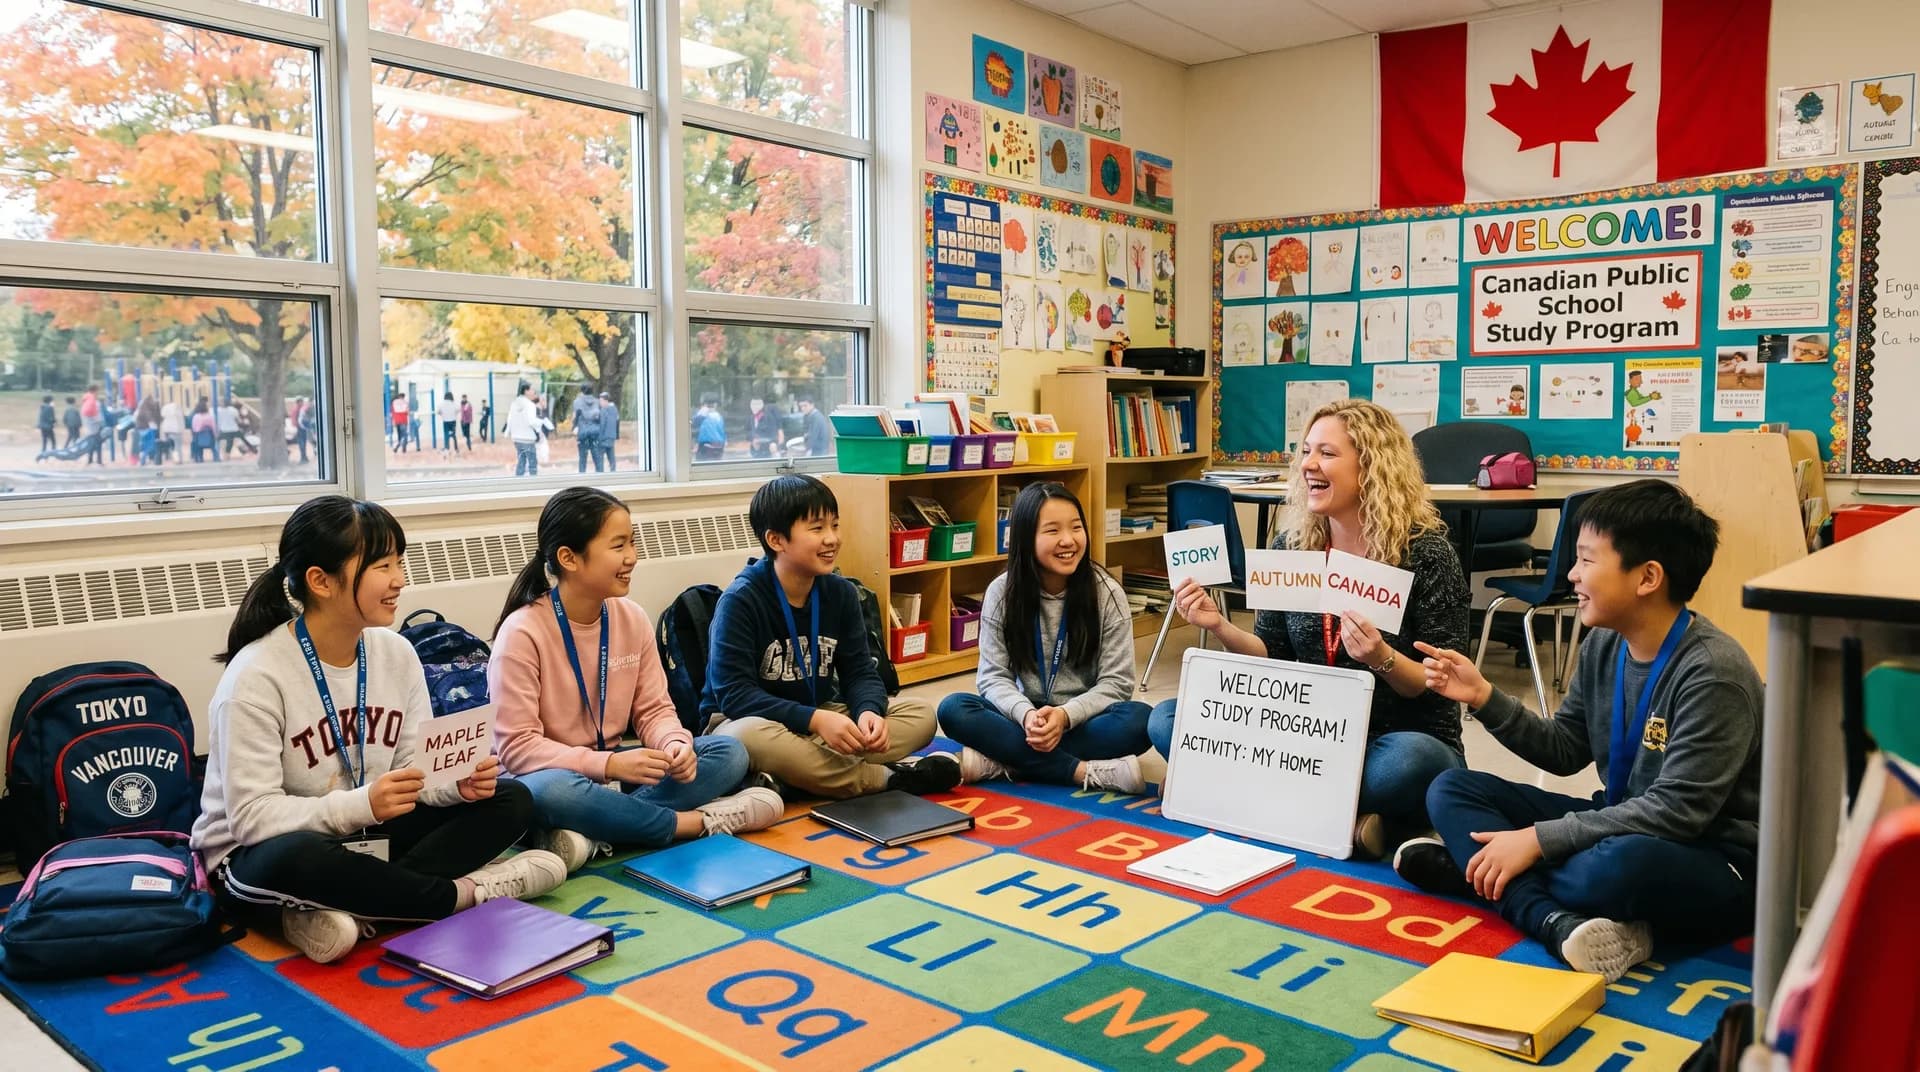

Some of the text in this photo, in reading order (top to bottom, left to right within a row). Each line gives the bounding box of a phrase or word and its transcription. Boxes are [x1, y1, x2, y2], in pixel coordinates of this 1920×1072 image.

[1473, 202, 1702, 256] WELCOME!
[1481, 262, 1690, 294] Canadian Public
[1538, 291, 1623, 316] School
[1487, 318, 1680, 345] Study Program
[1171, 545, 1220, 567] STORY
[1249, 570, 1322, 589] AUTUMN
[1327, 572, 1402, 609] CANADA
[1219, 670, 1313, 705] WELCOME
[75, 695, 148, 724] TOKYO
[1200, 699, 1347, 743] STUDY PROGRAM!
[290, 705, 404, 770] TOKYO
[425, 721, 487, 753] MAPLE
[1180, 733, 1324, 777] ACTIVITY: MY HOME
[70, 746, 179, 784] VANCOUVER
[432, 746, 478, 772] LEAF
[976, 870, 1123, 929] Hh
[1291, 884, 1484, 948] Dd
[706, 969, 869, 1059] Qq
[1062, 987, 1267, 1072] Mn
